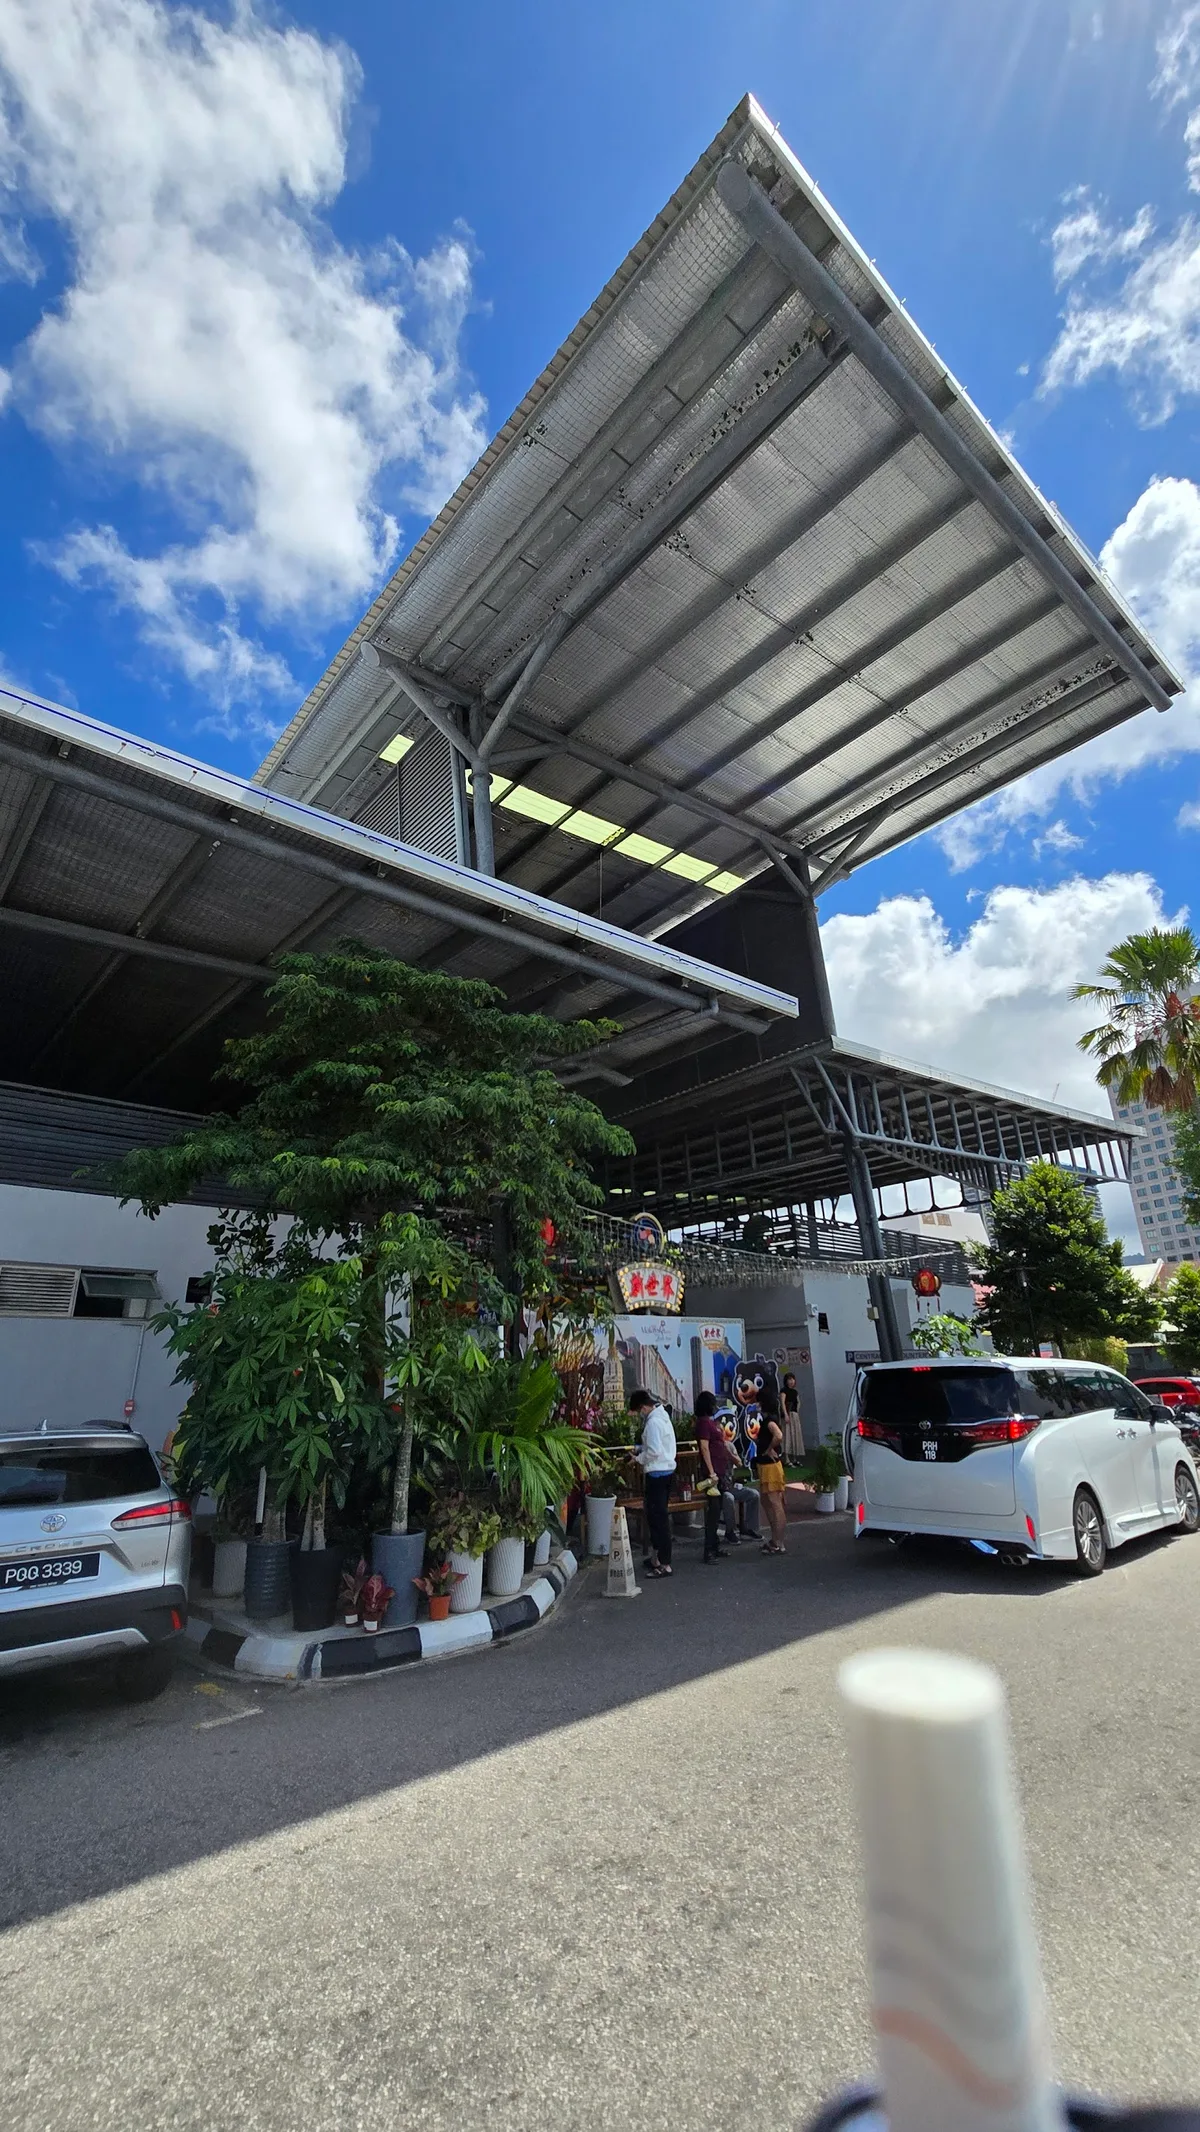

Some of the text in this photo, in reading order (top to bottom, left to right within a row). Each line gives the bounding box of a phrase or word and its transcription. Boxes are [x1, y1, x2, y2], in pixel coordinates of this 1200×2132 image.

[922, 1440, 938, 1451] PRH
[924, 1450, 937, 1461] 118
[5, 1565, 40, 1585] PQQ
[41, 1560, 83, 1579] 3339
